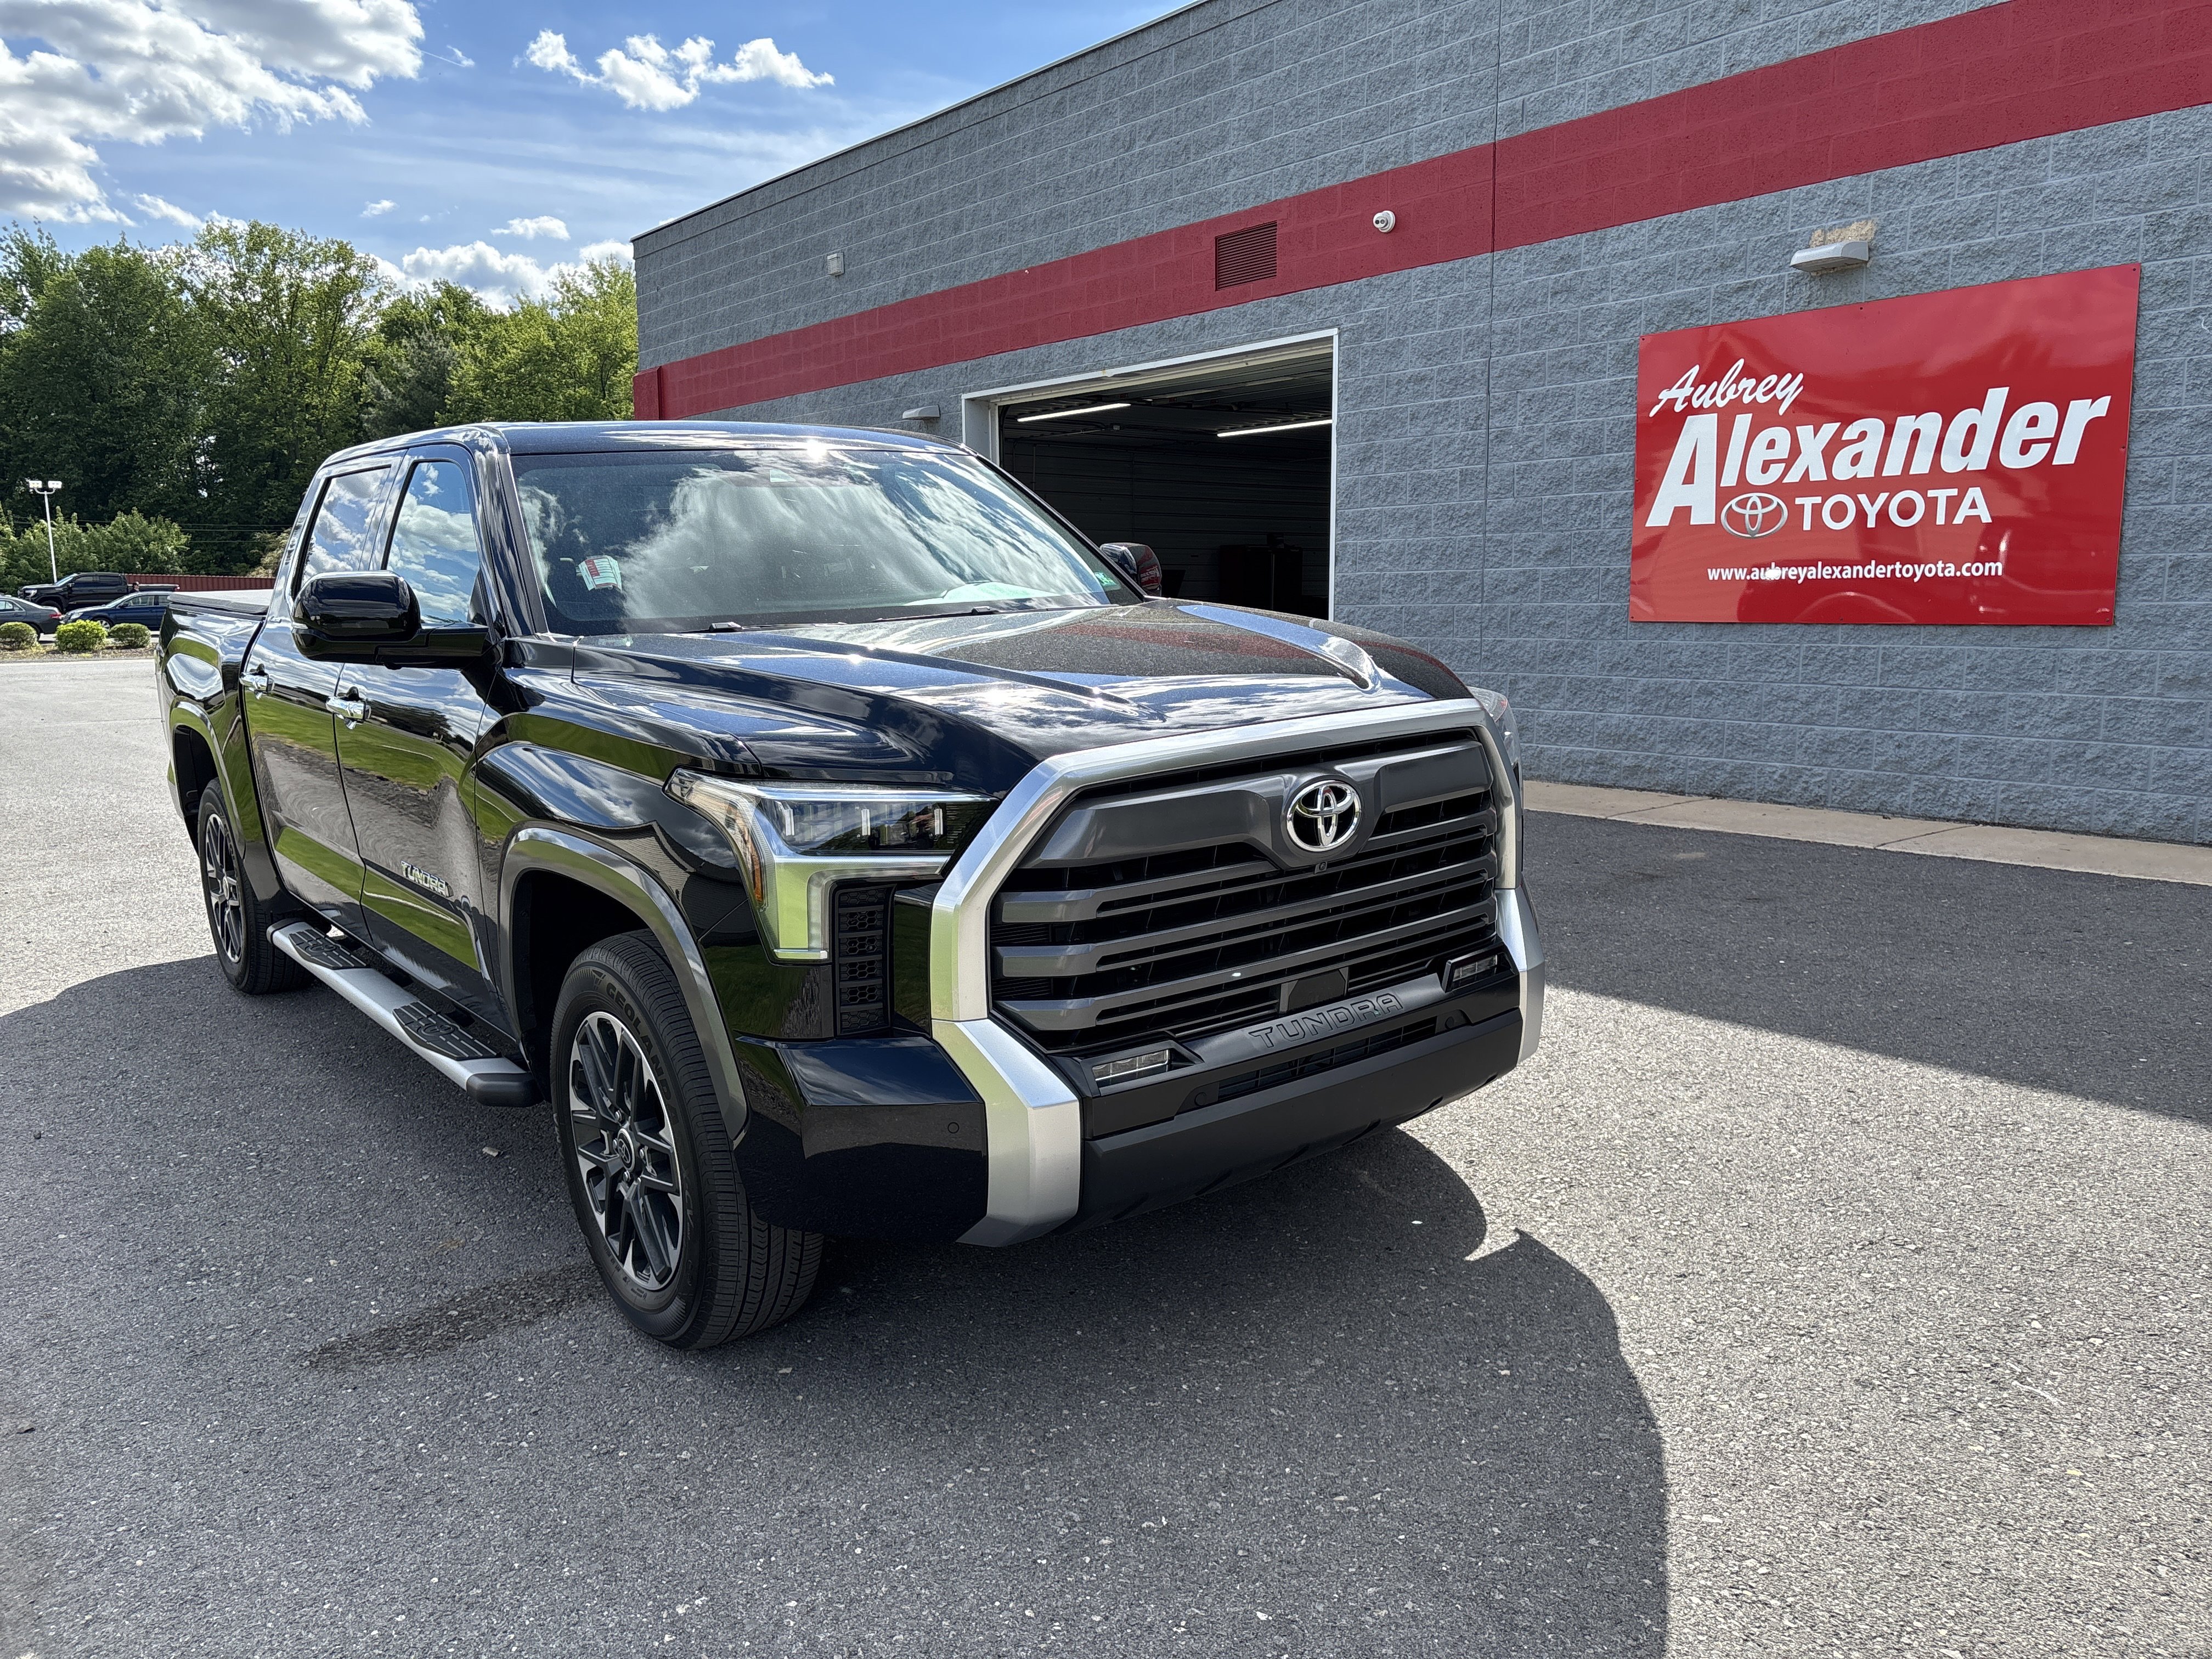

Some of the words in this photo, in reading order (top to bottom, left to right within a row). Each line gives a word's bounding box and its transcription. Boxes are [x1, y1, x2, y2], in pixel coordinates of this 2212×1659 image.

[1649, 358, 1804, 418] Aubrey
[1645, 386, 2113, 528] Alexander
[1795, 487, 1993, 532] TOYOTA
[401, 860, 449, 898] TUNDRA
[1248, 992, 1404, 1048] TUNDRA
